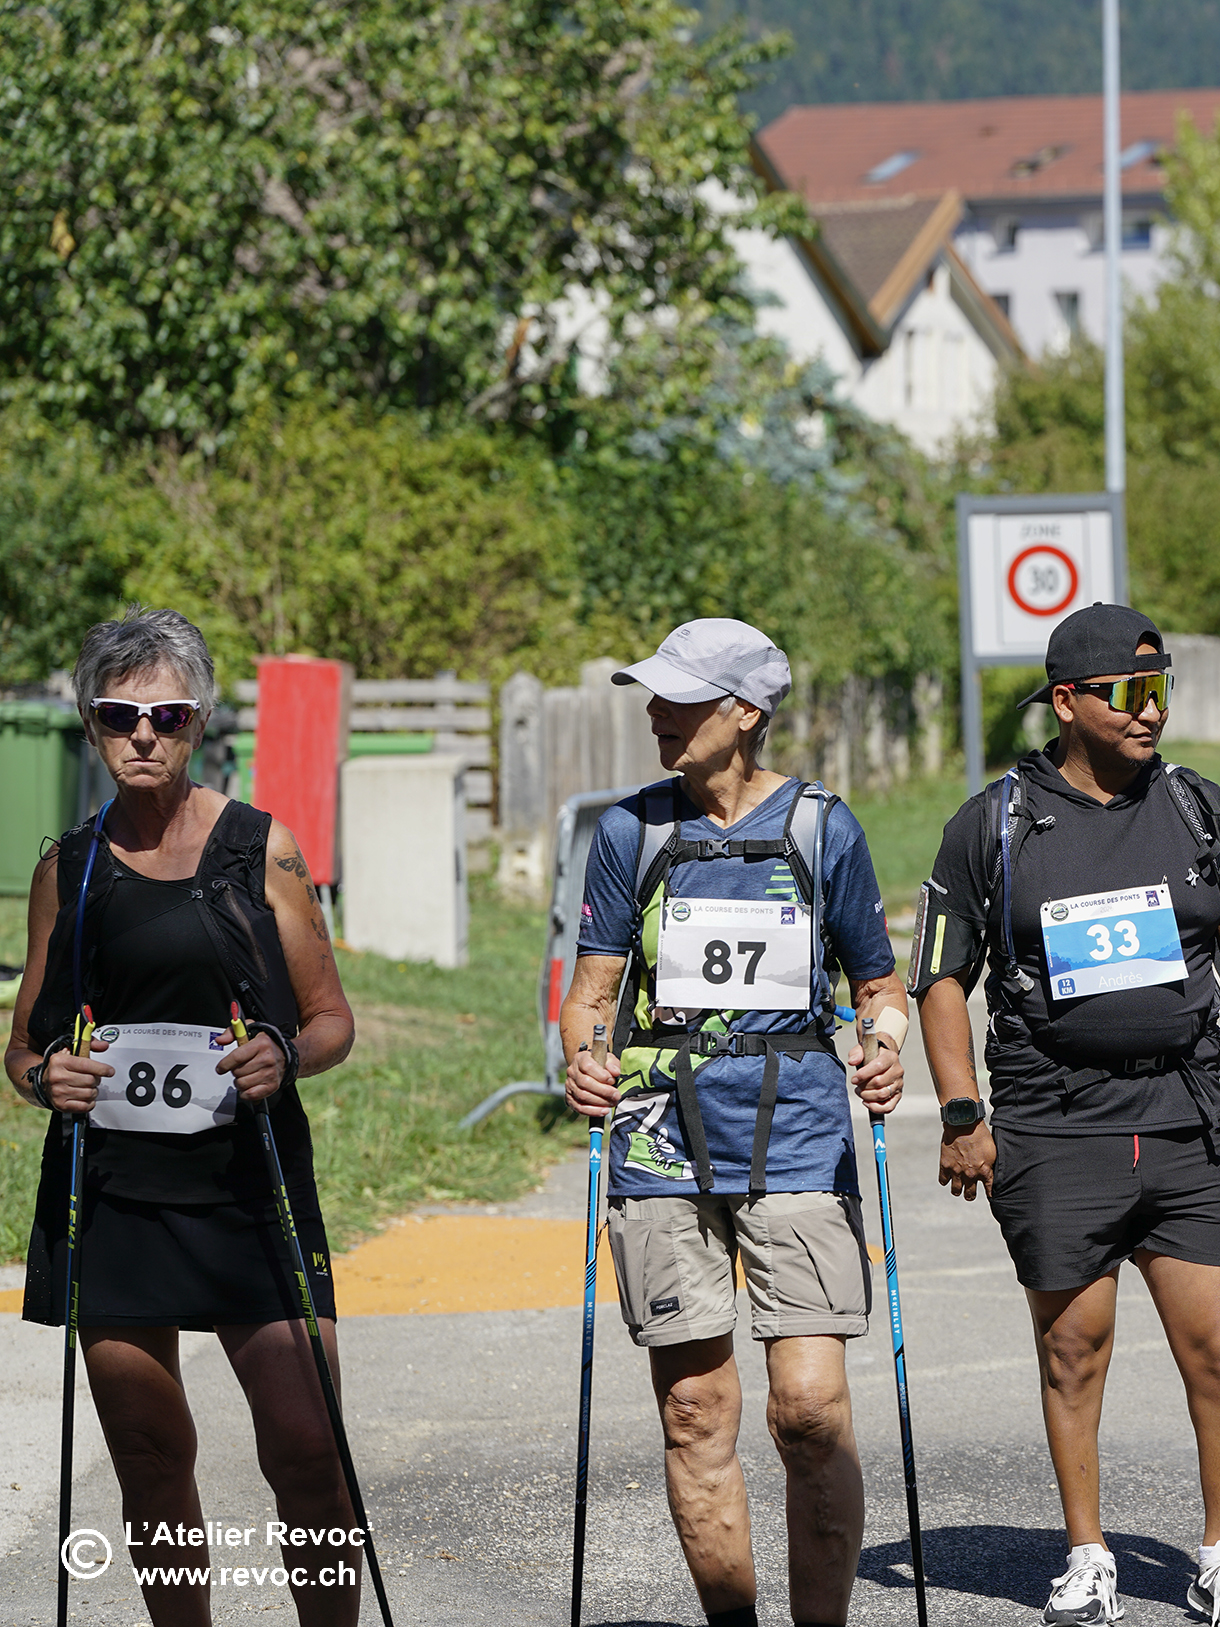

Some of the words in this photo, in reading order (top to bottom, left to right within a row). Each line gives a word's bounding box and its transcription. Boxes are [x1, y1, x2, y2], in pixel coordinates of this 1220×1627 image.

[1028, 565, 1059, 596] 30
[1080, 899, 1106, 908] COURSE
[1107, 896, 1119, 904] DES
[1086, 919, 1141, 961] 33
[702, 939, 767, 985] 87
[1062, 978, 1071, 986] 12
[1062, 985, 1074, 995] KM
[1098, 972, 1143, 988] Andrès
[178, 1030, 203, 1038] PONTS
[126, 1061, 192, 1108] 86
[69, 1280, 79, 1349] PRIME
[294, 1271, 318, 1337] PRIME
